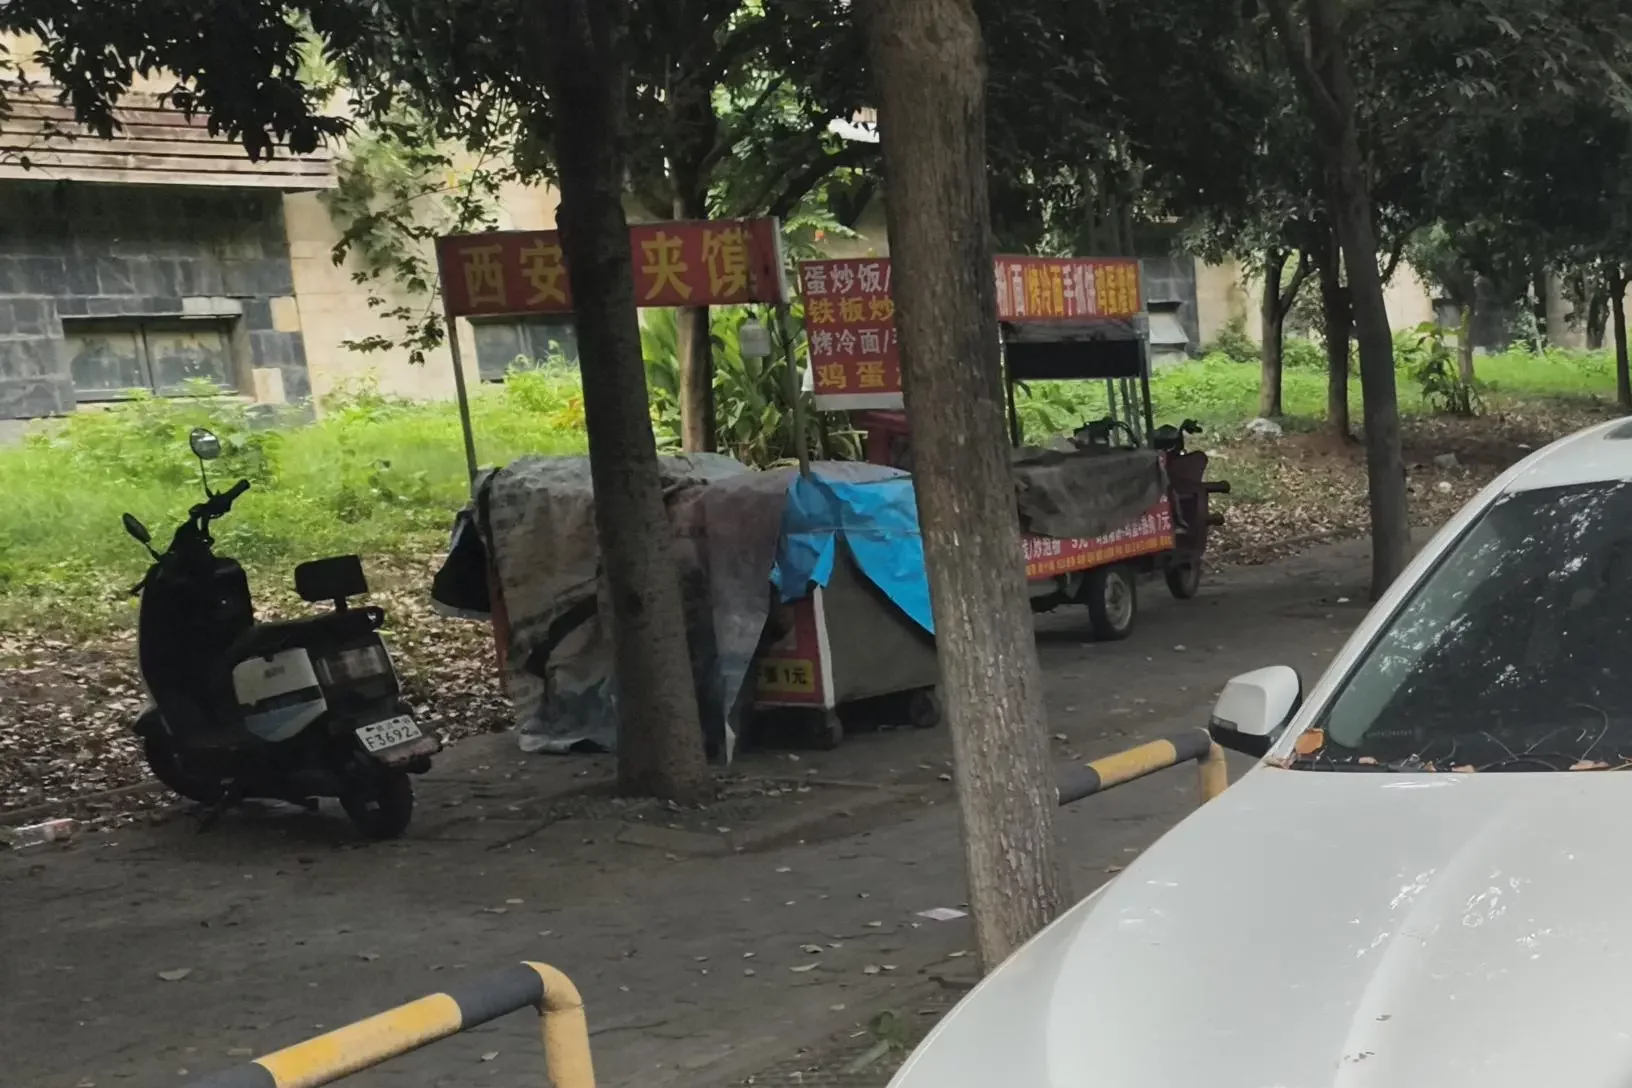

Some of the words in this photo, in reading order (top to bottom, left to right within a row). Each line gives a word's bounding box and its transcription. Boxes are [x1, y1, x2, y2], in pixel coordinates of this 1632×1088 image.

[459, 227, 754, 308] 西安夹馍
[808, 295, 895, 324] 铁板炒
[811, 327, 897, 356] 烤冷面/
[815, 361, 902, 389] 鸡蛋
